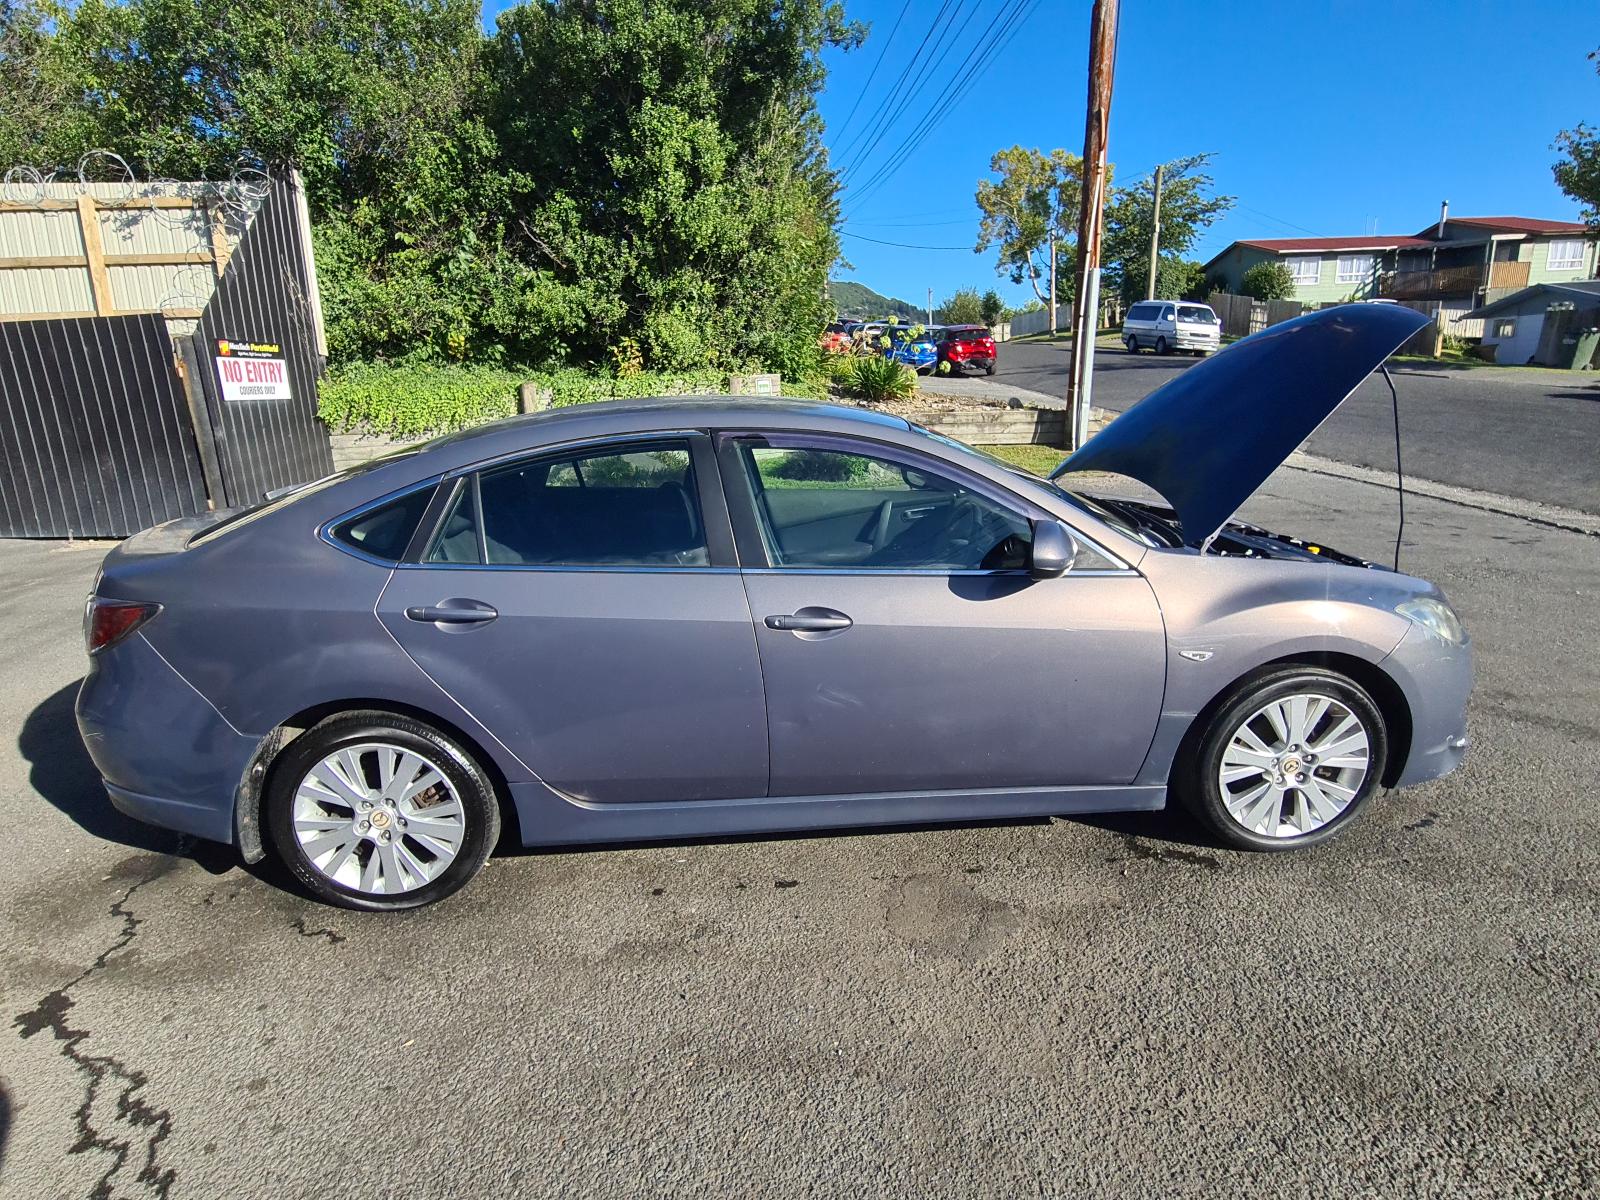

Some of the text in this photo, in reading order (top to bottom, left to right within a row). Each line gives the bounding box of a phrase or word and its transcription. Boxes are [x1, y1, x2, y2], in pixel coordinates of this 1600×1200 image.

[222, 360, 283, 383] NO ENTRY
[240, 386, 264, 395] COURIERS
